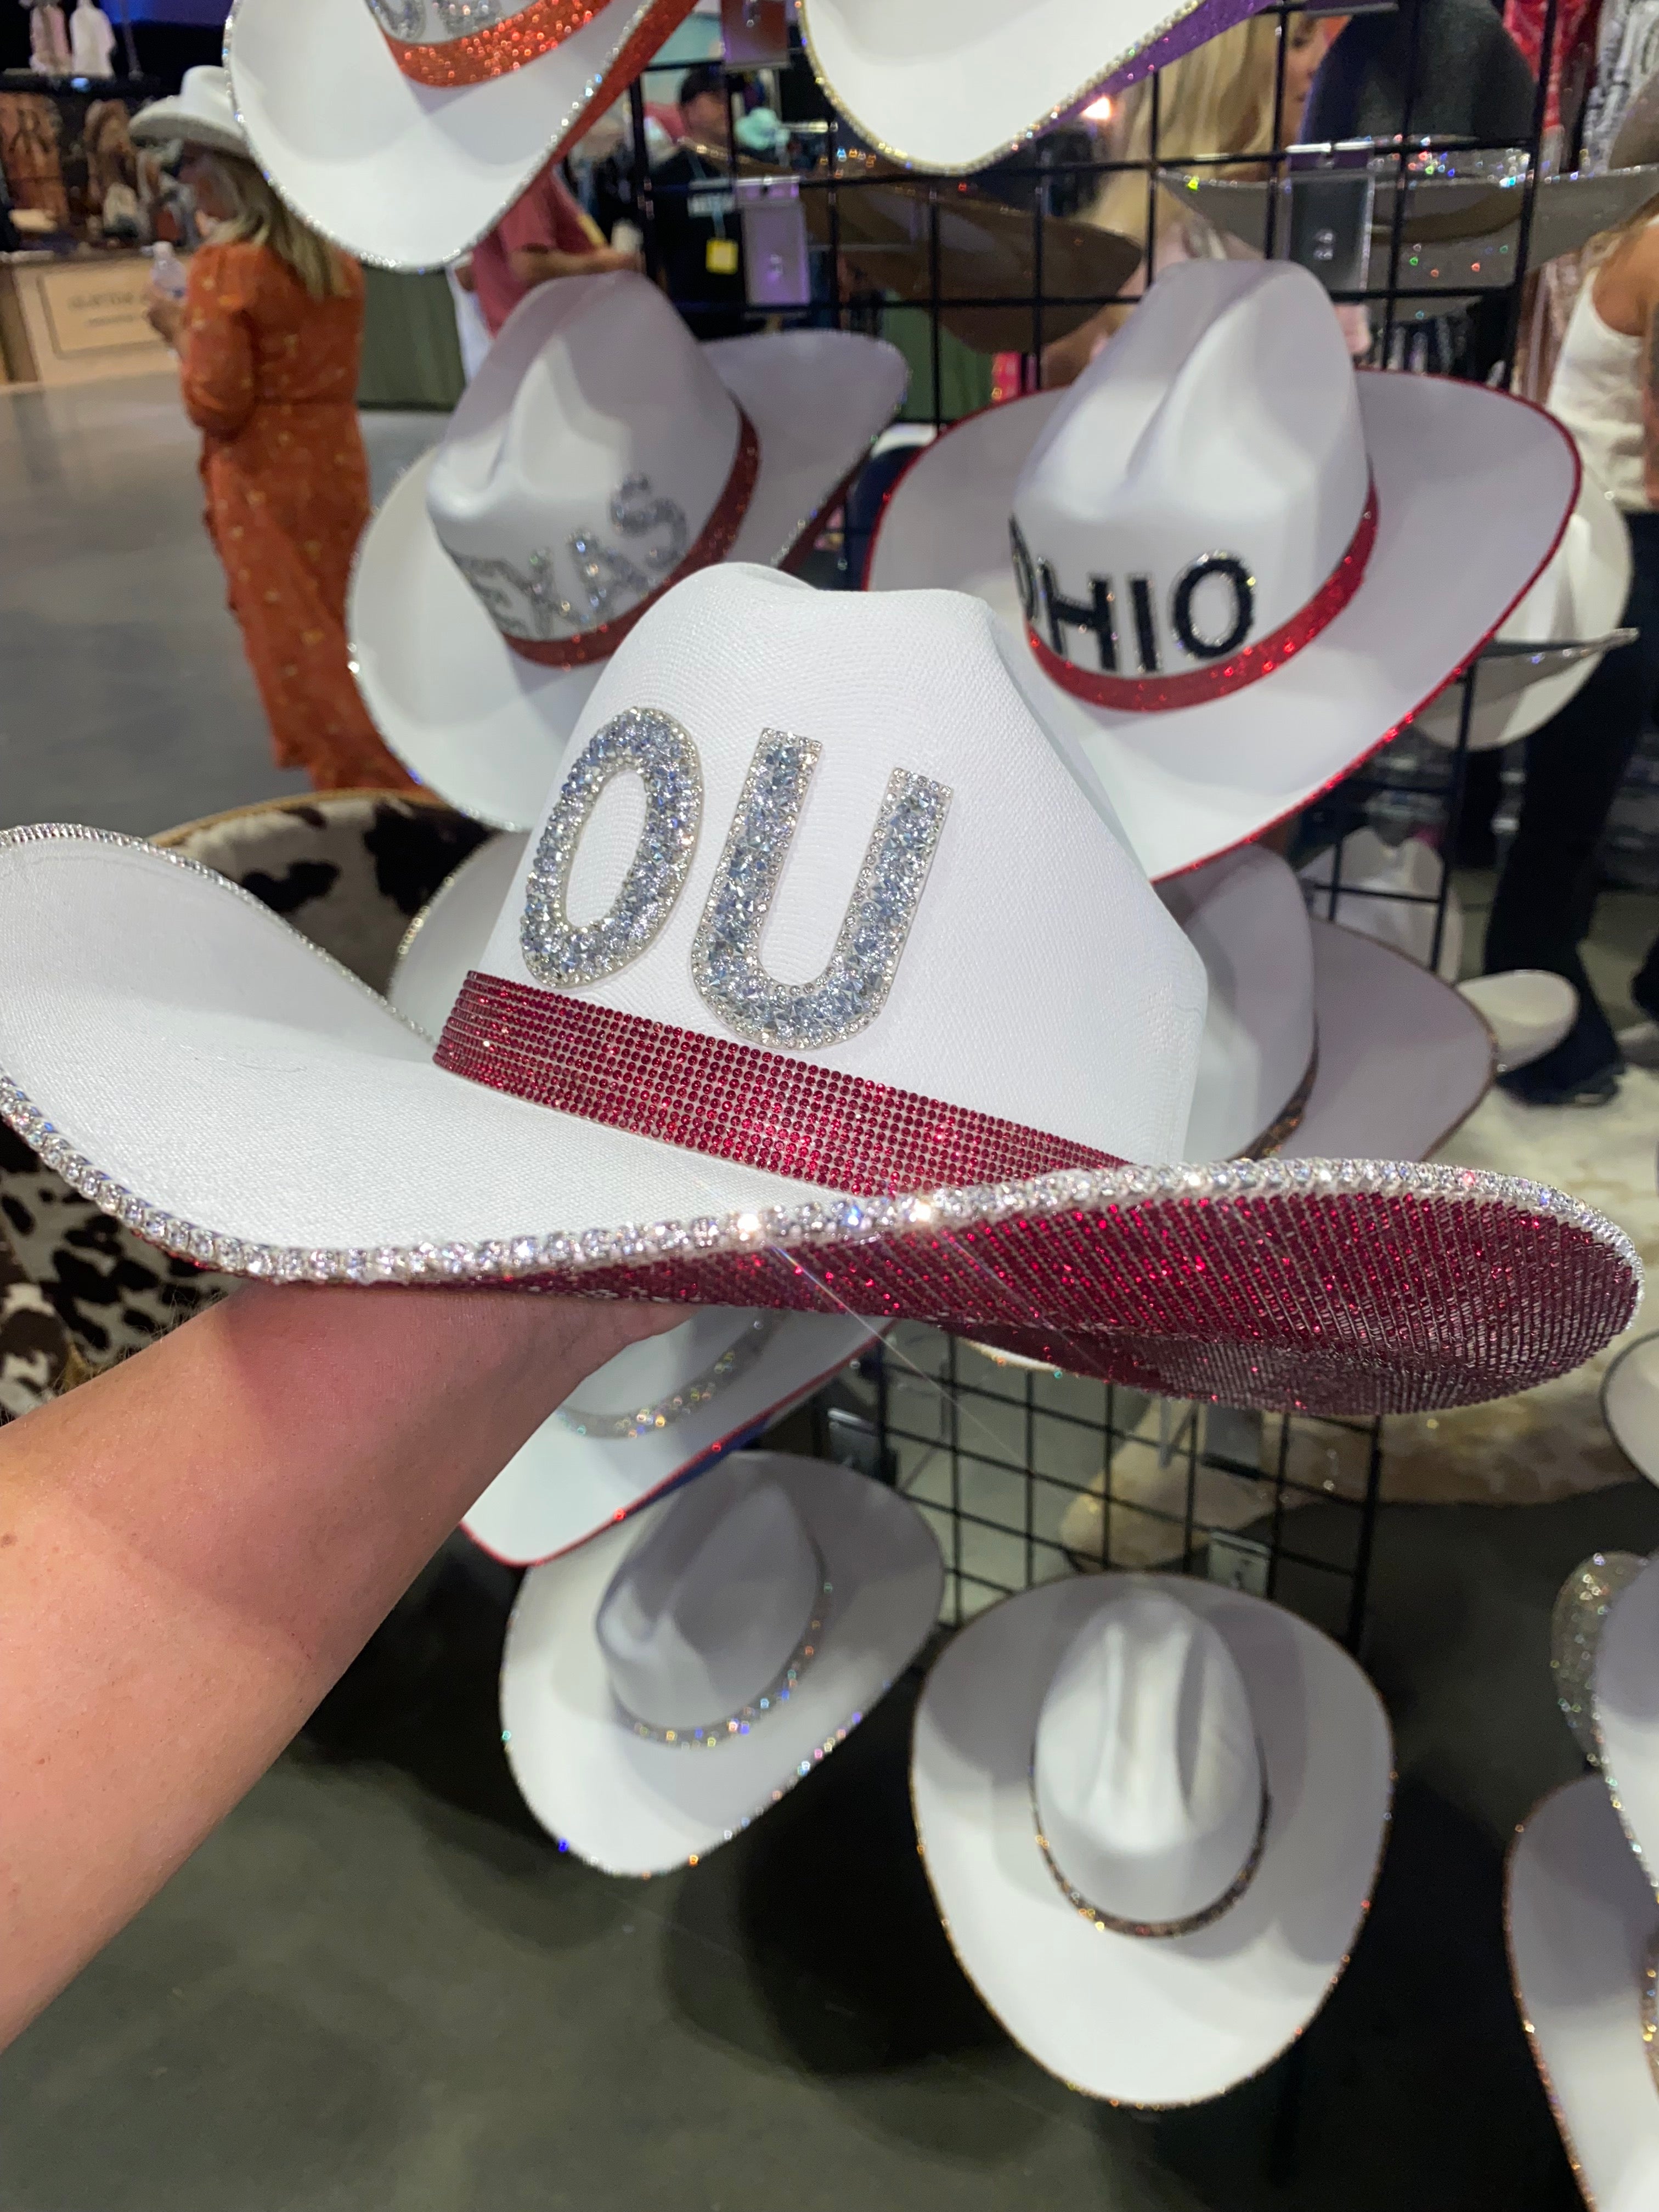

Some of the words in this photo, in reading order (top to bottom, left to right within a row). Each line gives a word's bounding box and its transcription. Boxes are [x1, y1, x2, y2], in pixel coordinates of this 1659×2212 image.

[452, 473, 686, 637] EXAS
[1008, 514, 1255, 674] OHIO
[521, 706, 953, 1050] OU
